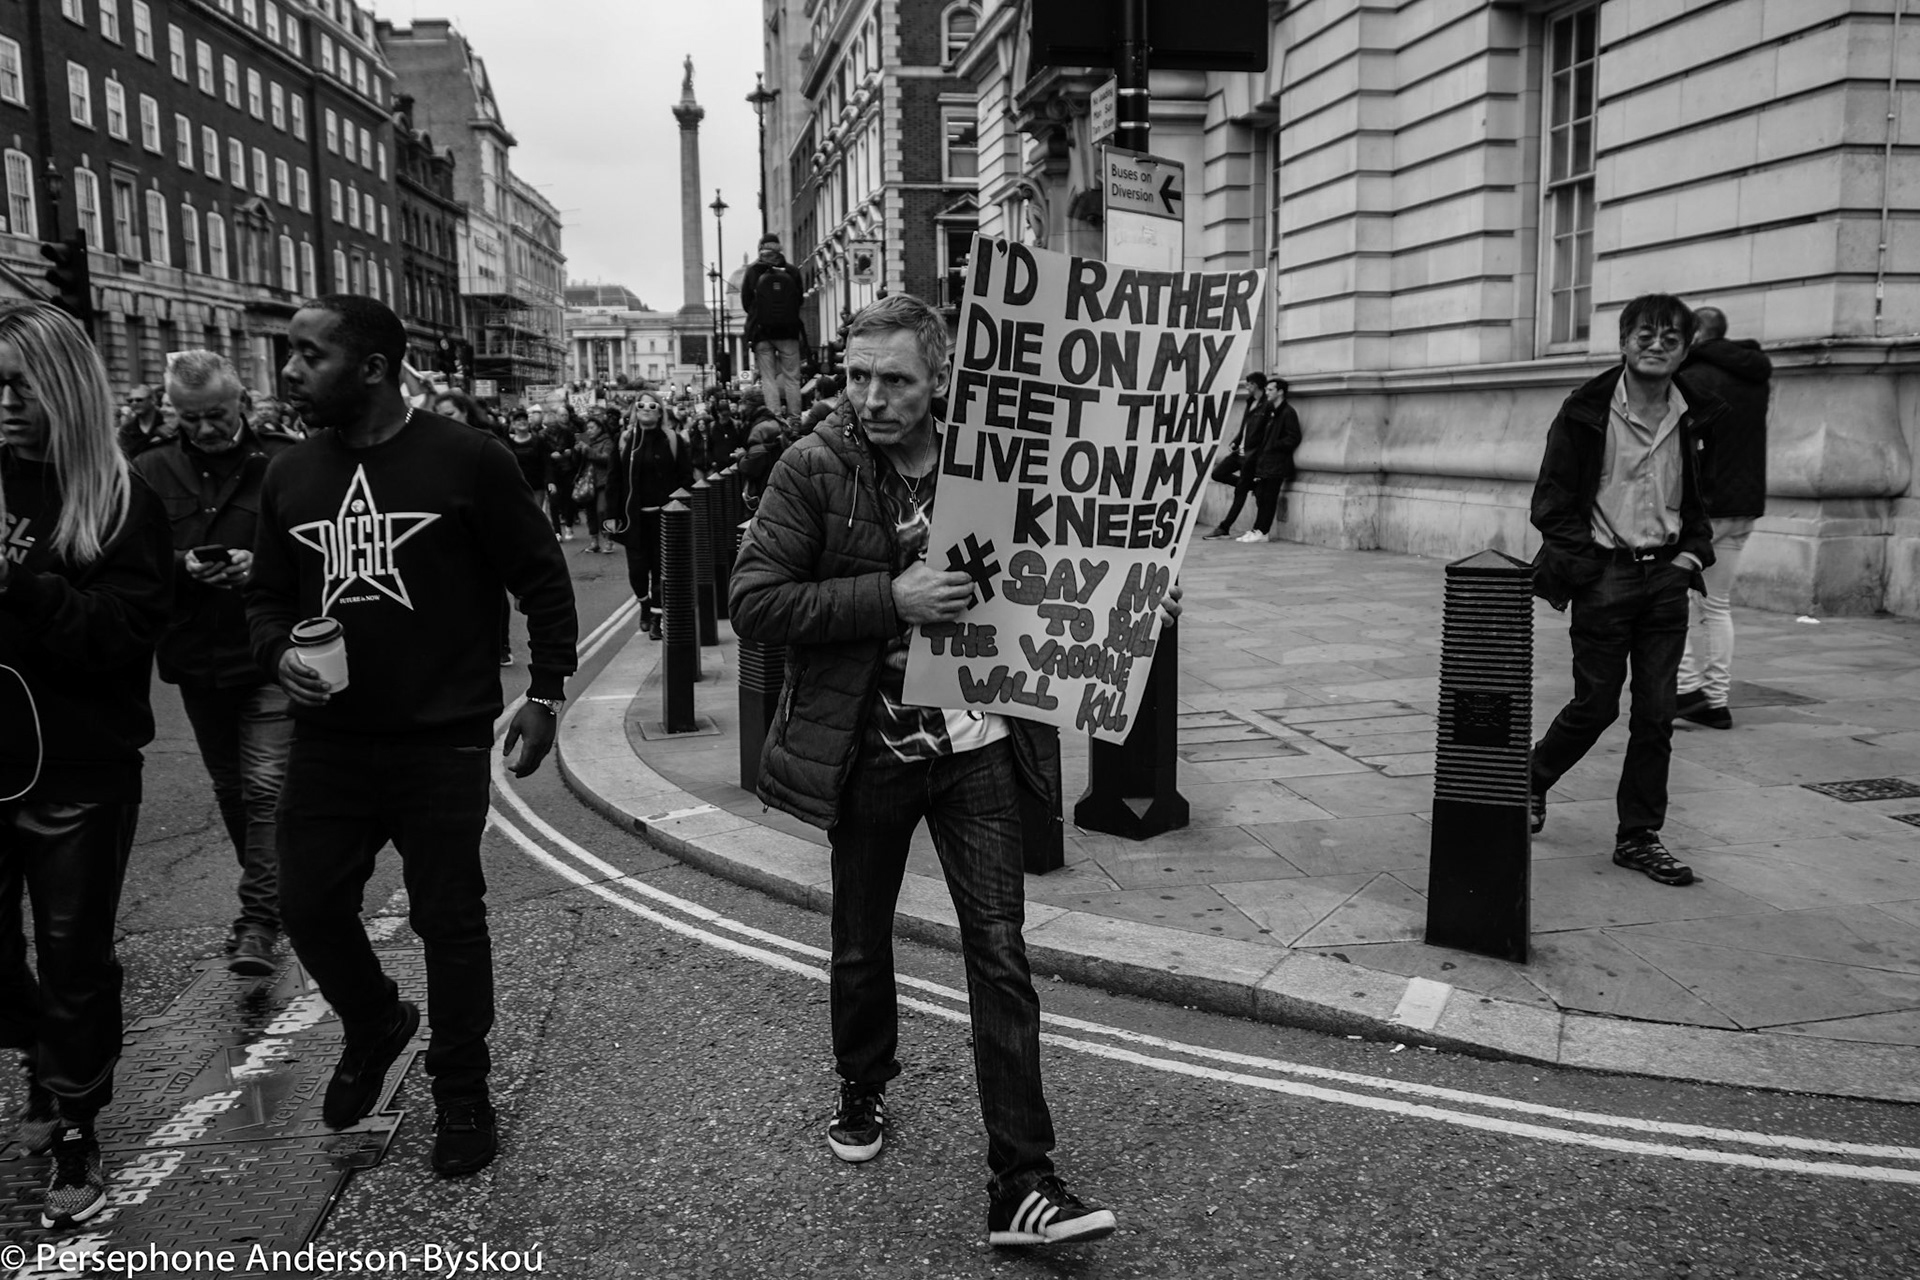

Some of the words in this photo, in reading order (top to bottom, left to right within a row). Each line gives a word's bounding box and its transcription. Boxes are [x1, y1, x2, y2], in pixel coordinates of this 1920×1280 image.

[1111, 163, 1138, 181] Buses
[1140, 172, 1153, 183] on
[1111, 182, 1154, 203] Diversion
[973, 237, 1039, 306] I'D
[1065, 256, 1259, 331] RATHER
[963, 302, 1045, 376] DIE
[1058, 328, 1141, 390] ON
[1147, 331, 1236, 394] MY
[952, 369, 1100, 438] FEET
[1117, 390, 1232, 444] THAN
[942, 424, 1050, 485] LIVE
[1060, 440, 1138, 499] ON
[1142, 444, 1219, 505] MY
[1012, 488, 1190, 559] KNEES!
[1116, 562, 1170, 613] NO
[920, 621, 998, 658] THE
[1019, 634, 1134, 692] VACCINE
[1037, 603, 1095, 643] TO
[1103, 607, 1156, 658] BILL
[958, 665, 1059, 711] WILL
[1075, 682, 1129, 736] KILL
